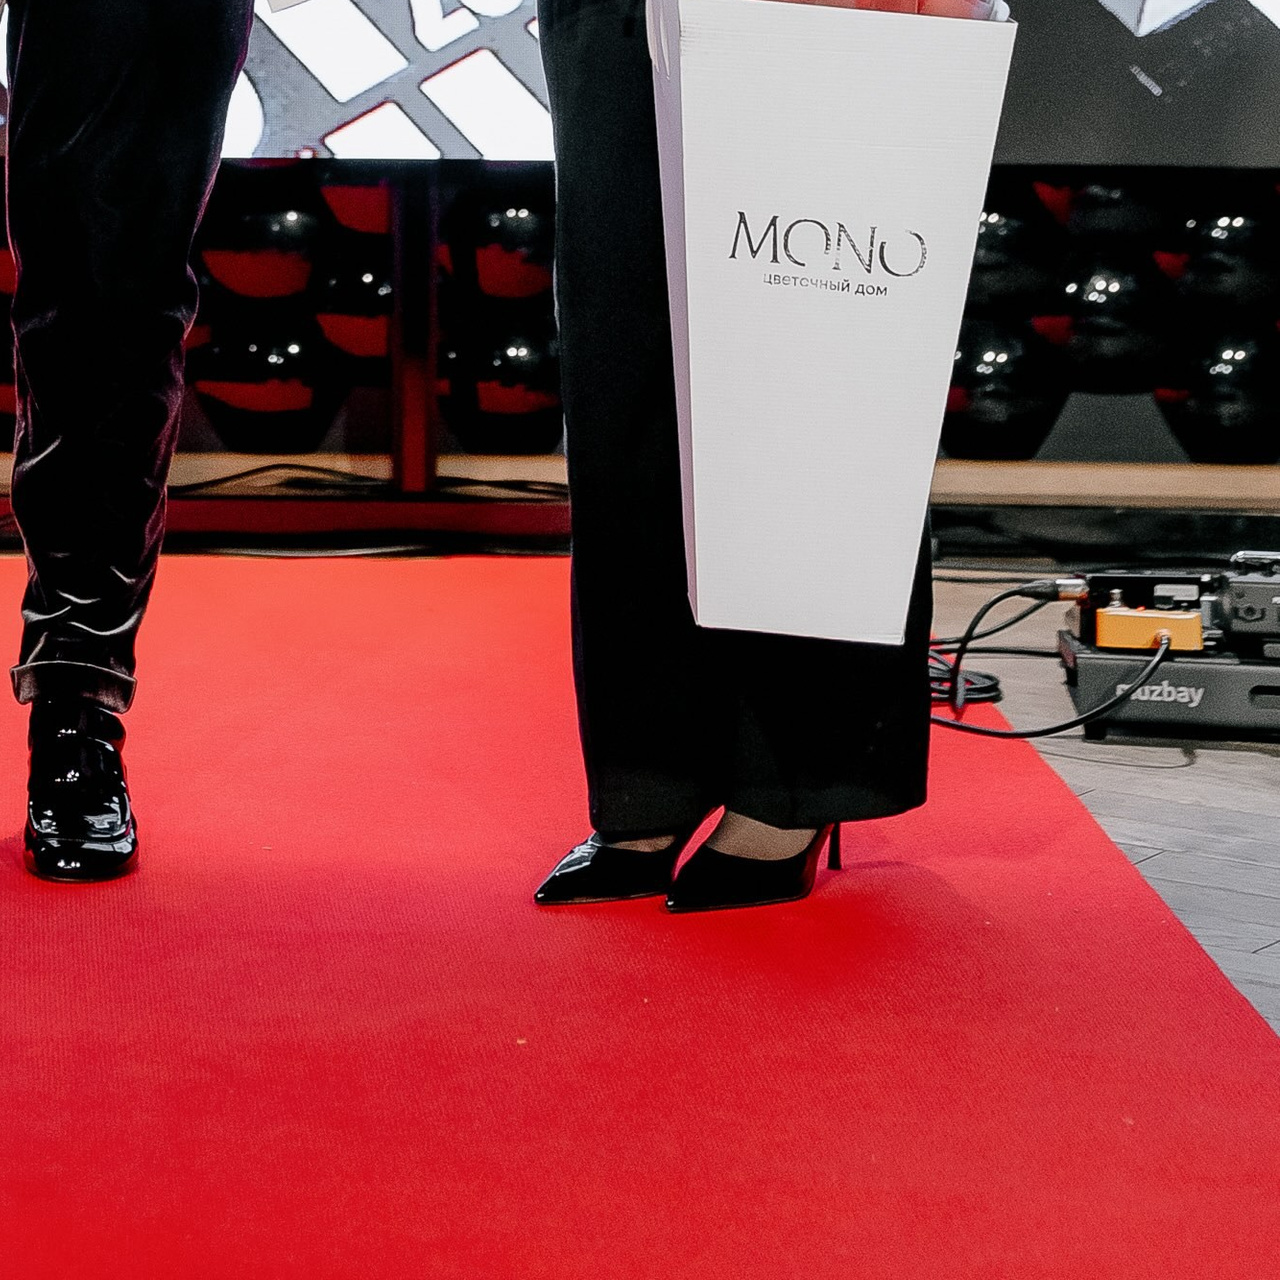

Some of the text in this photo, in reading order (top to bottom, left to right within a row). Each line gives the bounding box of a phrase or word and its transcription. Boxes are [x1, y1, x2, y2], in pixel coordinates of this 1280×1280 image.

[728, 210, 928, 278] MONO
[763, 272, 888, 297] цветочный дом
